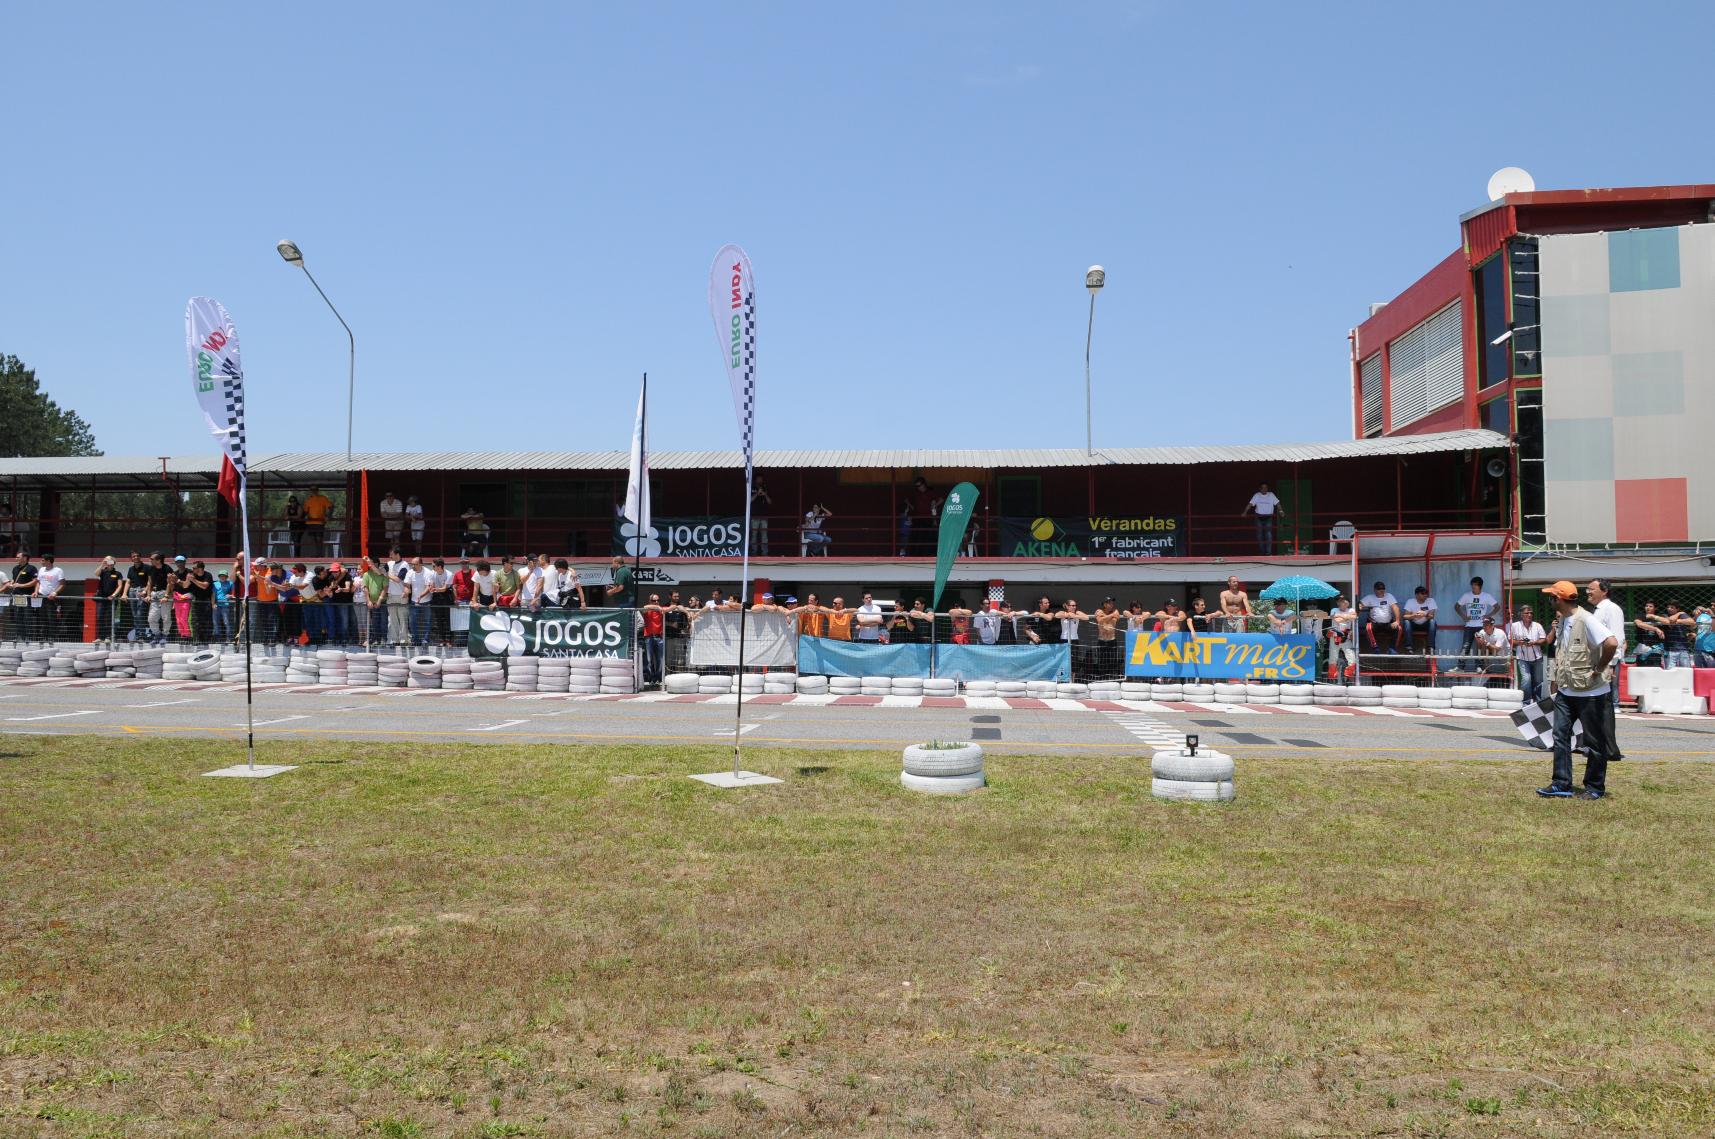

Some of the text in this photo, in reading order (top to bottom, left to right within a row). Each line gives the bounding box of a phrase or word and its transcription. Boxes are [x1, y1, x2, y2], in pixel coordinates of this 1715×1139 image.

[1088, 515, 1177, 531] Vérandas
[667, 523, 742, 554] JOGOS
[1112, 536, 1174, 548] fabricant
[676, 546, 742, 558] SANTACASA
[1012, 541, 1082, 557] AKENA
[533, 620, 622, 653] JOGOS
[543, 648, 619, 660] SANTACASA
[1130, 632, 1312, 678] KART mag
